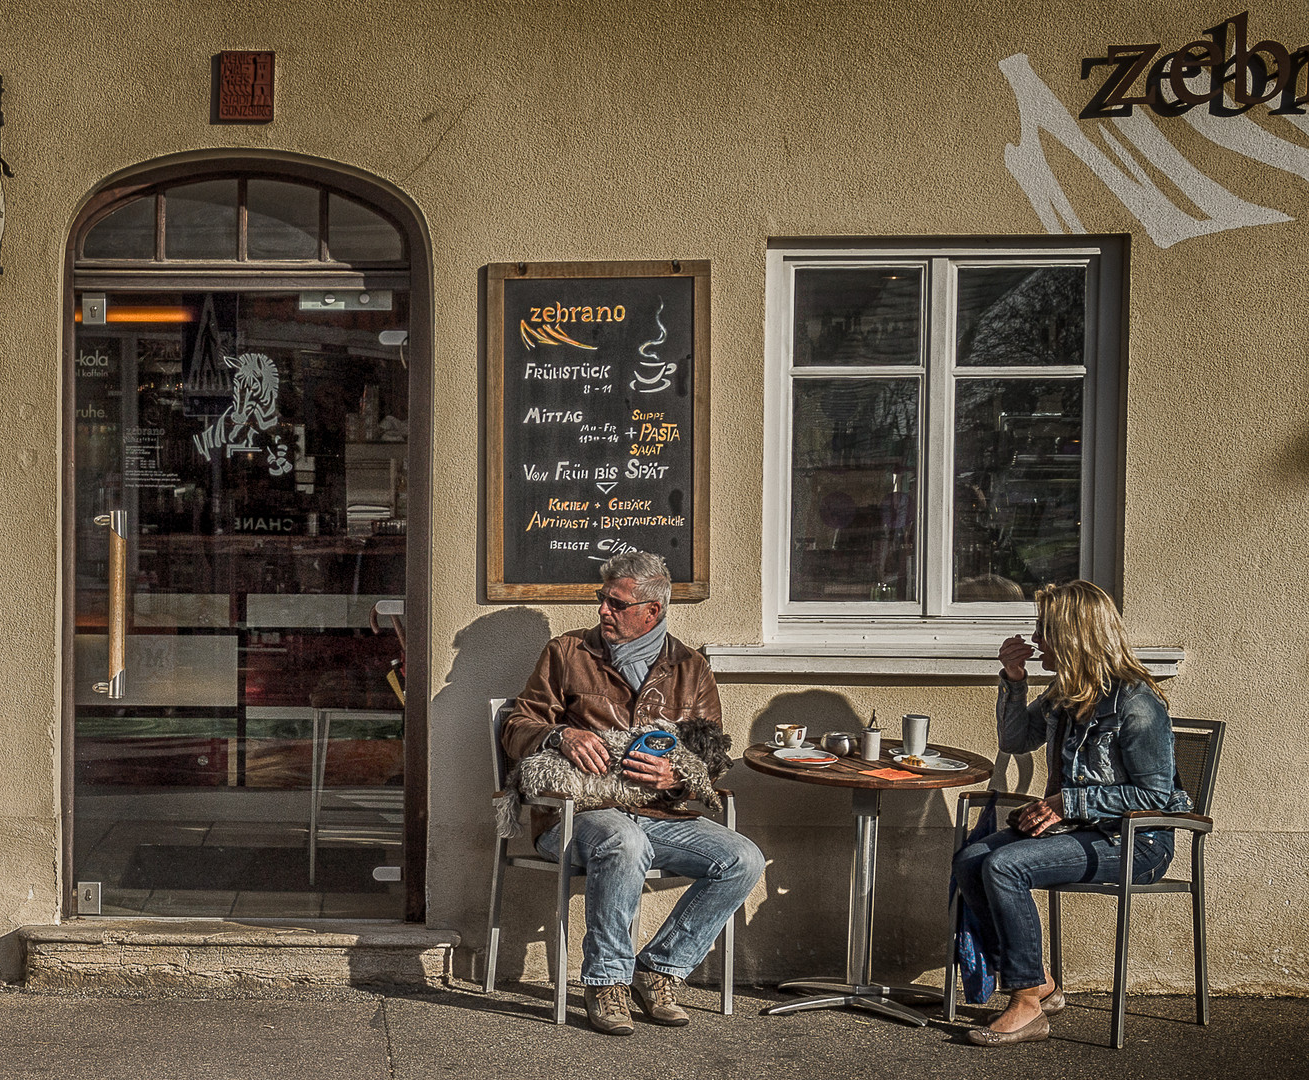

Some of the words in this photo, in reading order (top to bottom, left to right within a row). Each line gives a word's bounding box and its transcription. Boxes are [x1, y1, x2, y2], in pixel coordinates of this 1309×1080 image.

[530, 301, 626, 322] zebrano
[524, 362, 611, 380] FRÜHSTÜCK
[631, 409, 665, 420] SUPPE
[639, 422, 681, 442] PASTA
[629, 443, 664, 456] SALAT
[523, 464, 549, 481] VON
[555, 461, 589, 481] FRÜH
[624, 458, 669, 479] SPÄT
[548, 498, 589, 511] KUCHEN
[608, 497, 652, 511] GEBÄCK
[549, 540, 590, 550] BELEGTE
